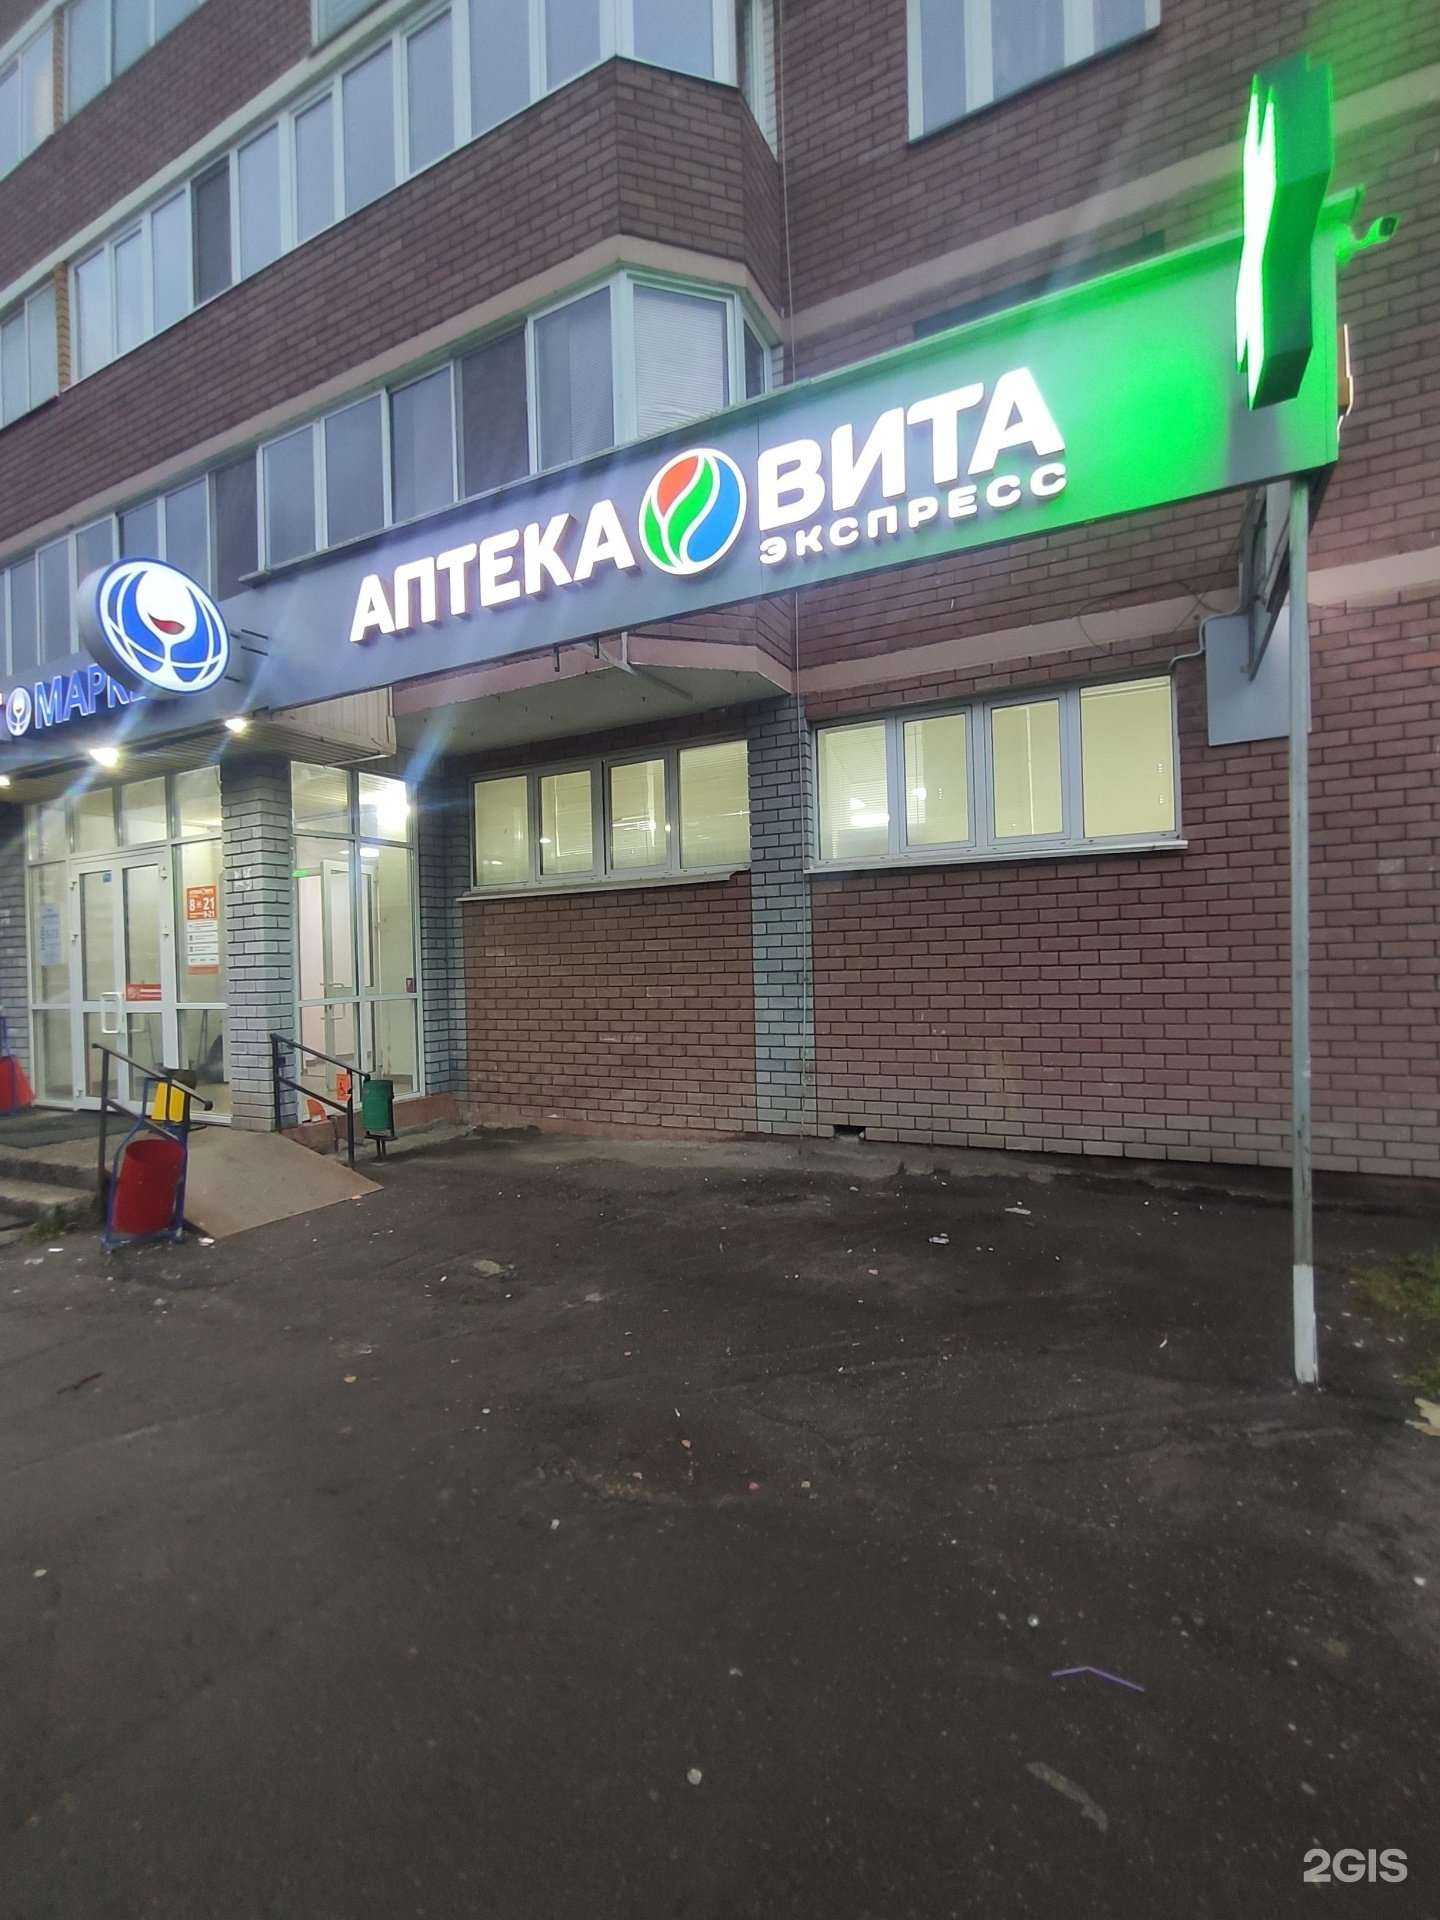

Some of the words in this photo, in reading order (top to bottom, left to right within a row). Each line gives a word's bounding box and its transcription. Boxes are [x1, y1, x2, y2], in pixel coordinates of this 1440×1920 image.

[350, 499, 636, 642] АПТЕКА
[757, 366, 1067, 531] ВИТА
[759, 462, 1067, 566] ЭКСПРЕСС
